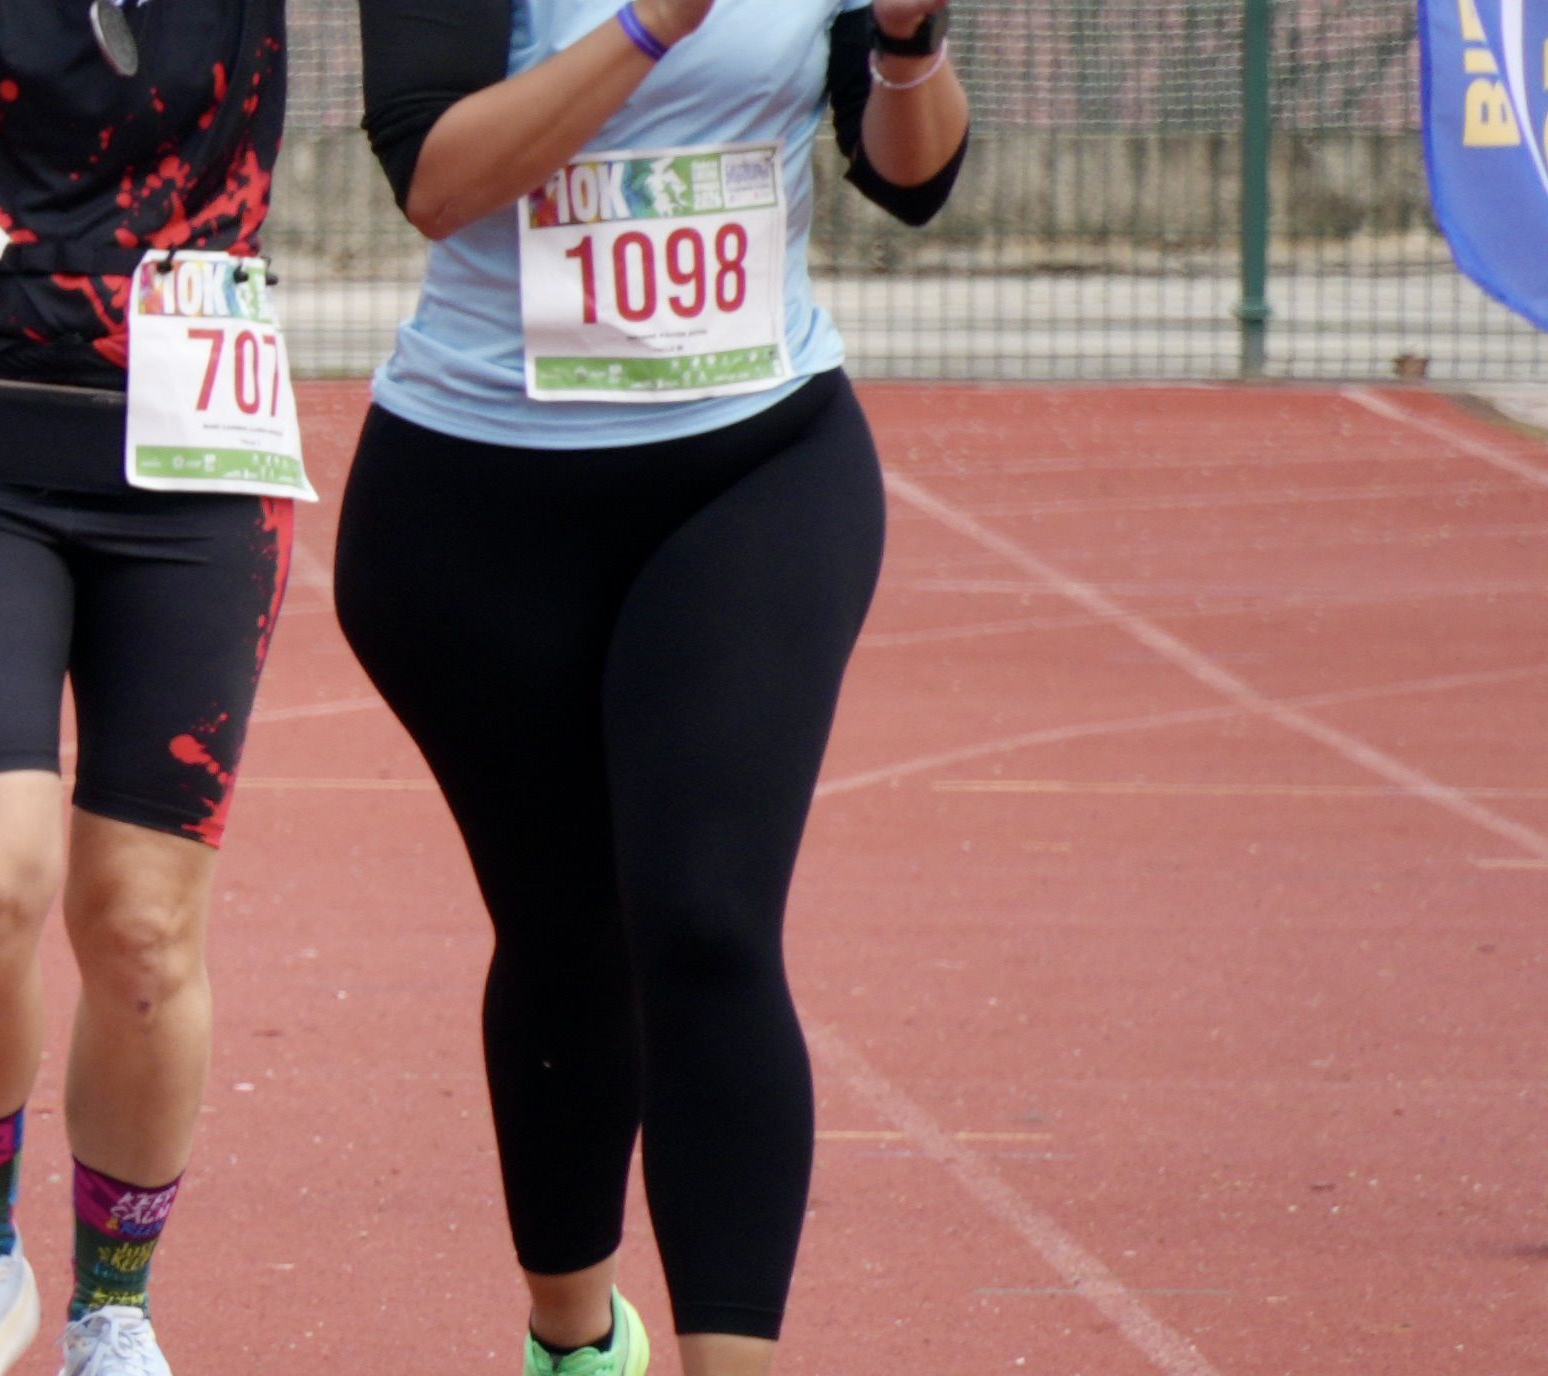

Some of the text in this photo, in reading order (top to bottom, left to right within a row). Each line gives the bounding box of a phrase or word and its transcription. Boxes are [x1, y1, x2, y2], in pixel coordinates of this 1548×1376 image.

[544, 161, 632, 224] 10K
[158, 260, 230, 316] 10K
[564, 222, 748, 325] 1098
[187, 327, 281, 419] 707
